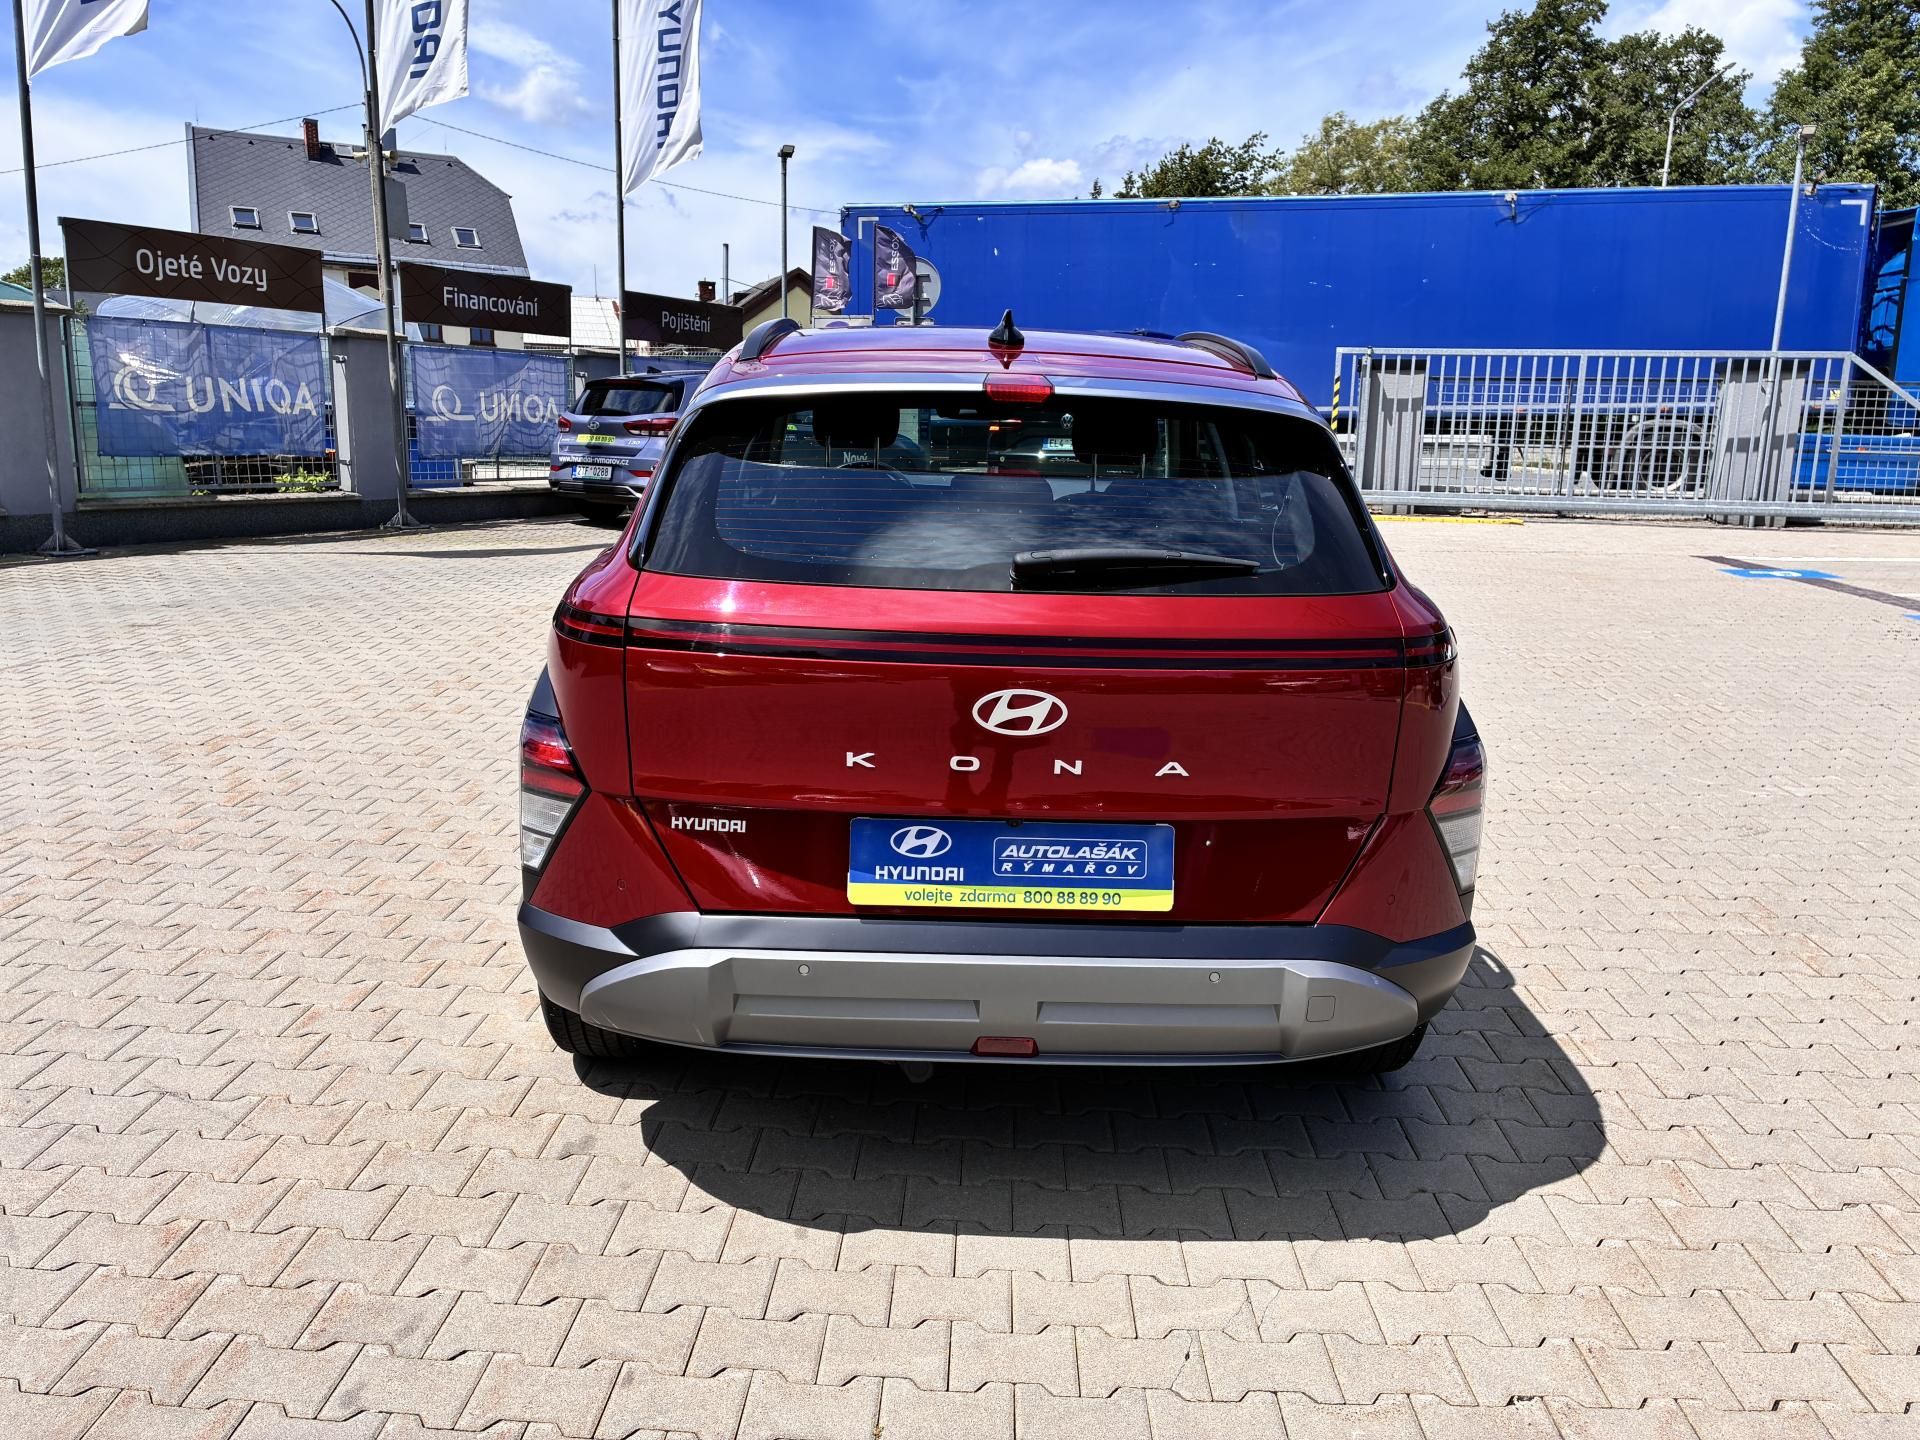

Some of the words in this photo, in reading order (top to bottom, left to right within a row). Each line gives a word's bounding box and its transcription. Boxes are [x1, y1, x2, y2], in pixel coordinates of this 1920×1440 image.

[891, 235, 900, 271] ESSOX
[136, 248, 203, 281] Ojeté
[210, 257, 267, 292] Vozy
[443, 286, 538, 317] Financování
[661, 311, 711, 333] Pojištění
[185, 375, 317, 416] UNIQA
[479, 391, 559, 424] UNIQA
[846, 751, 1190, 777] KONA
[671, 816, 747, 833] HYUNDAI
[1001, 842, 1139, 860] AUTOLAŠÁK
[875, 865, 964, 882] HYUNDAI
[1000, 861, 1138, 875] RÝMAŘOV
[904, 888, 953, 903] volejte
[959, 888, 1016, 903] zdarma
[1023, 890, 1053, 904] 800
[1056, 891, 1075, 904] 88
[1079, 892, 1098, 905] 89
[1101, 892, 1122, 905] 90
